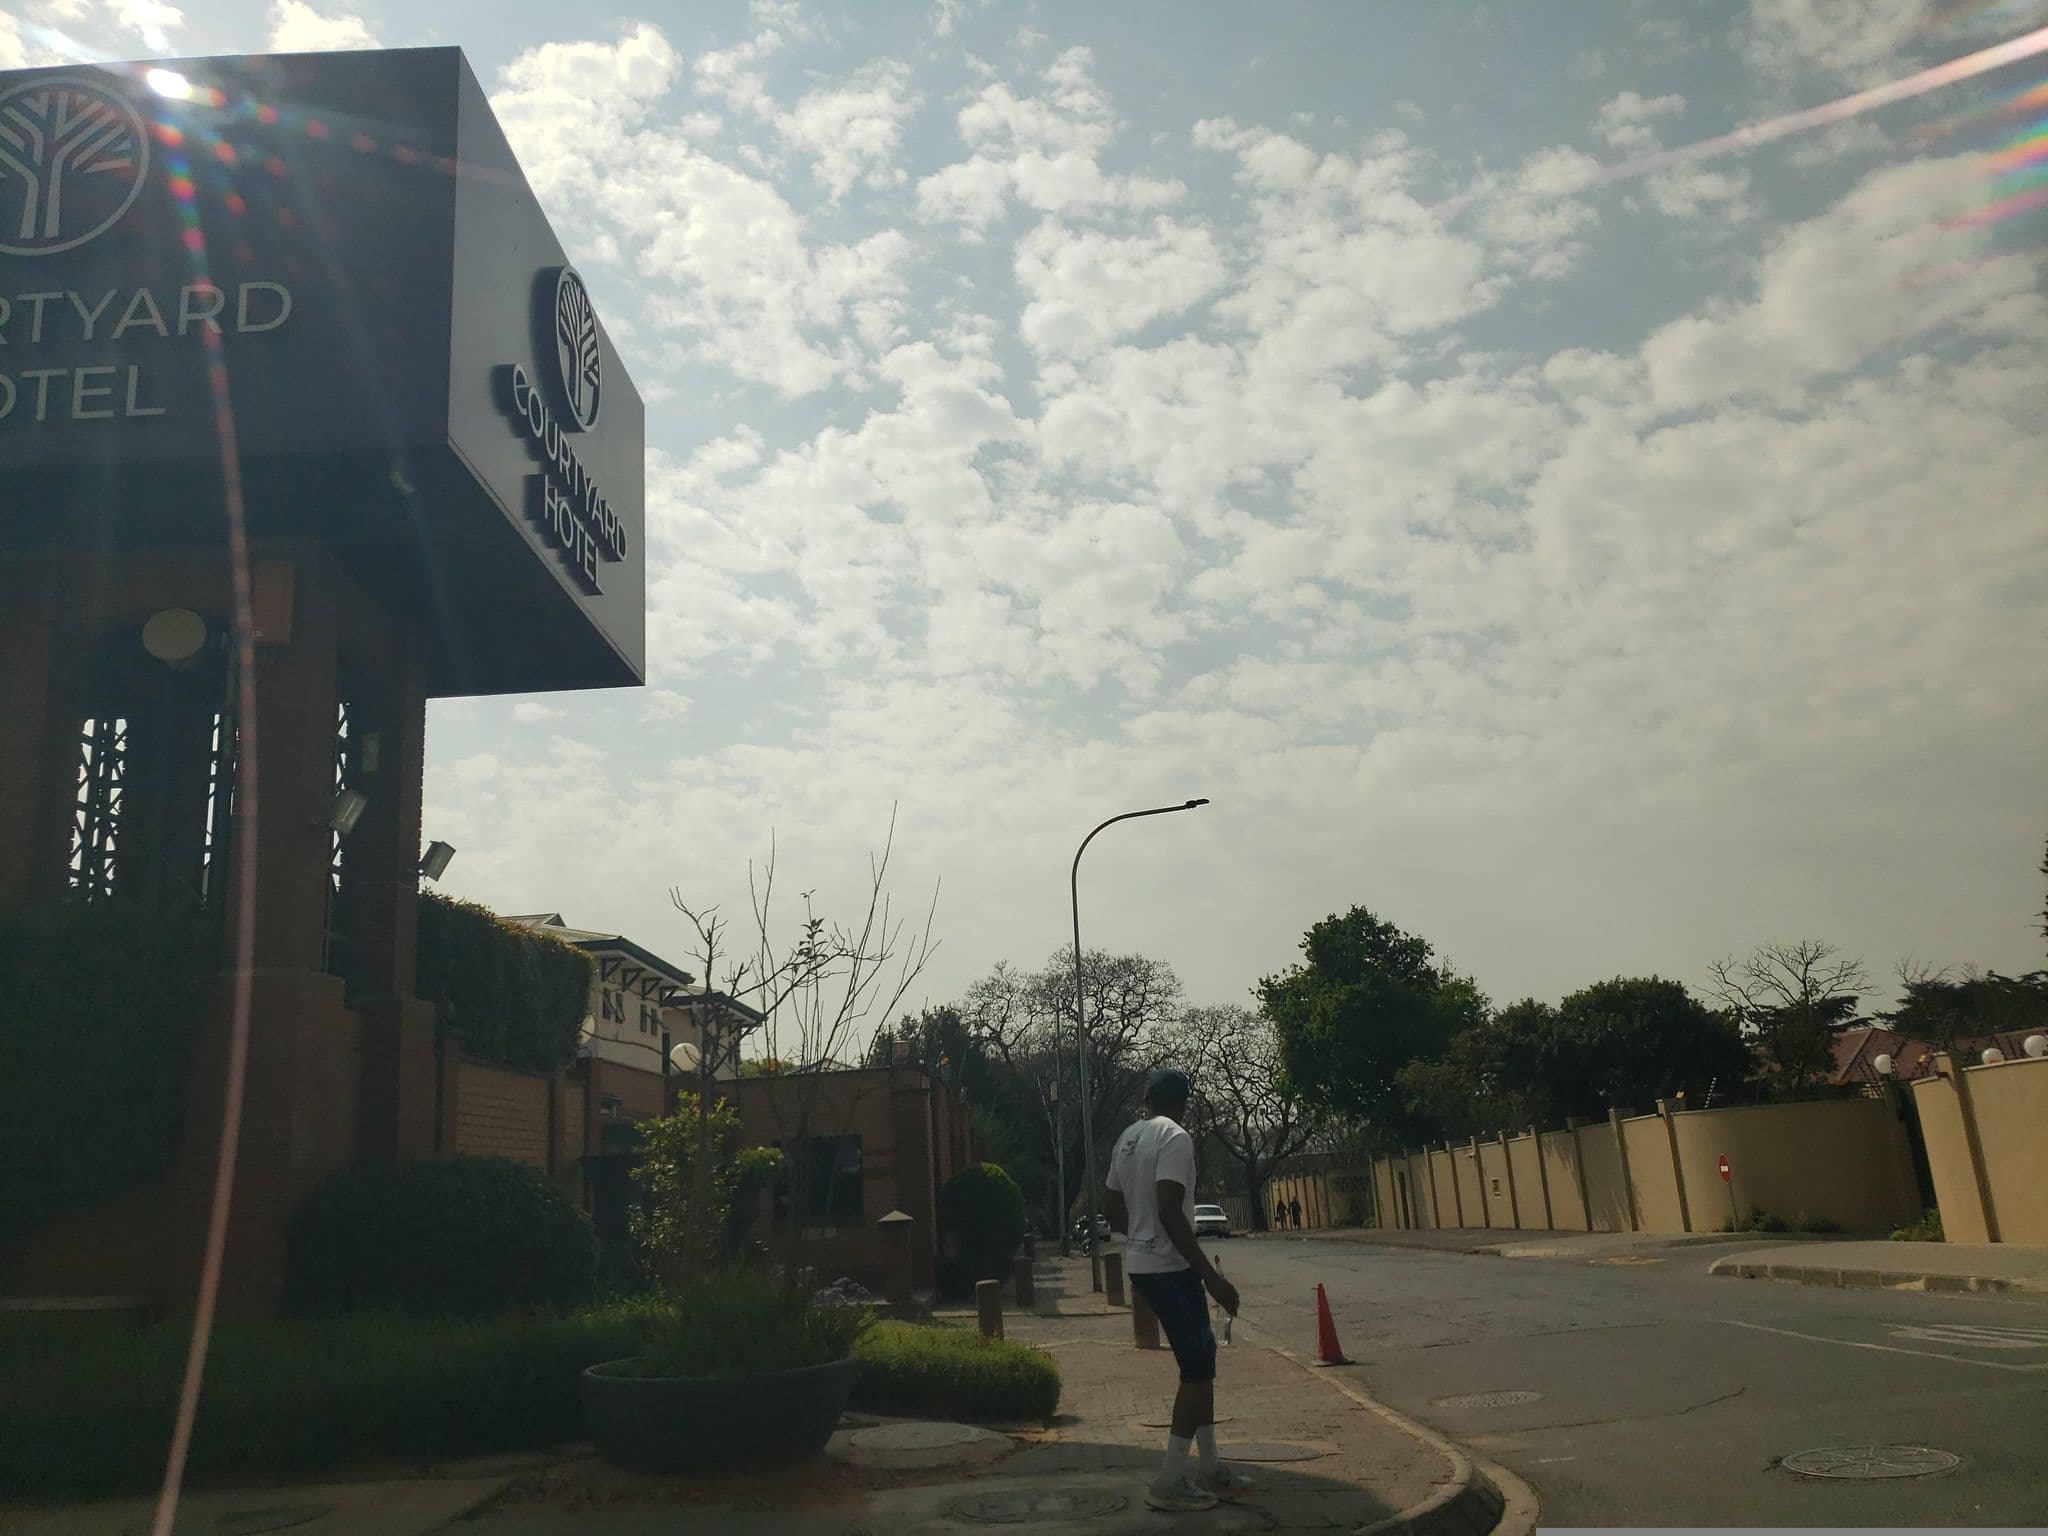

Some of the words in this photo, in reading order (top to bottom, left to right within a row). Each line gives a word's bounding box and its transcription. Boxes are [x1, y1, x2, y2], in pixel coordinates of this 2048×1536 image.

[0, 281, 292, 344] TYARD
[513, 363, 627, 561] COURTYARD
[545, 474, 604, 595] HOTEL
